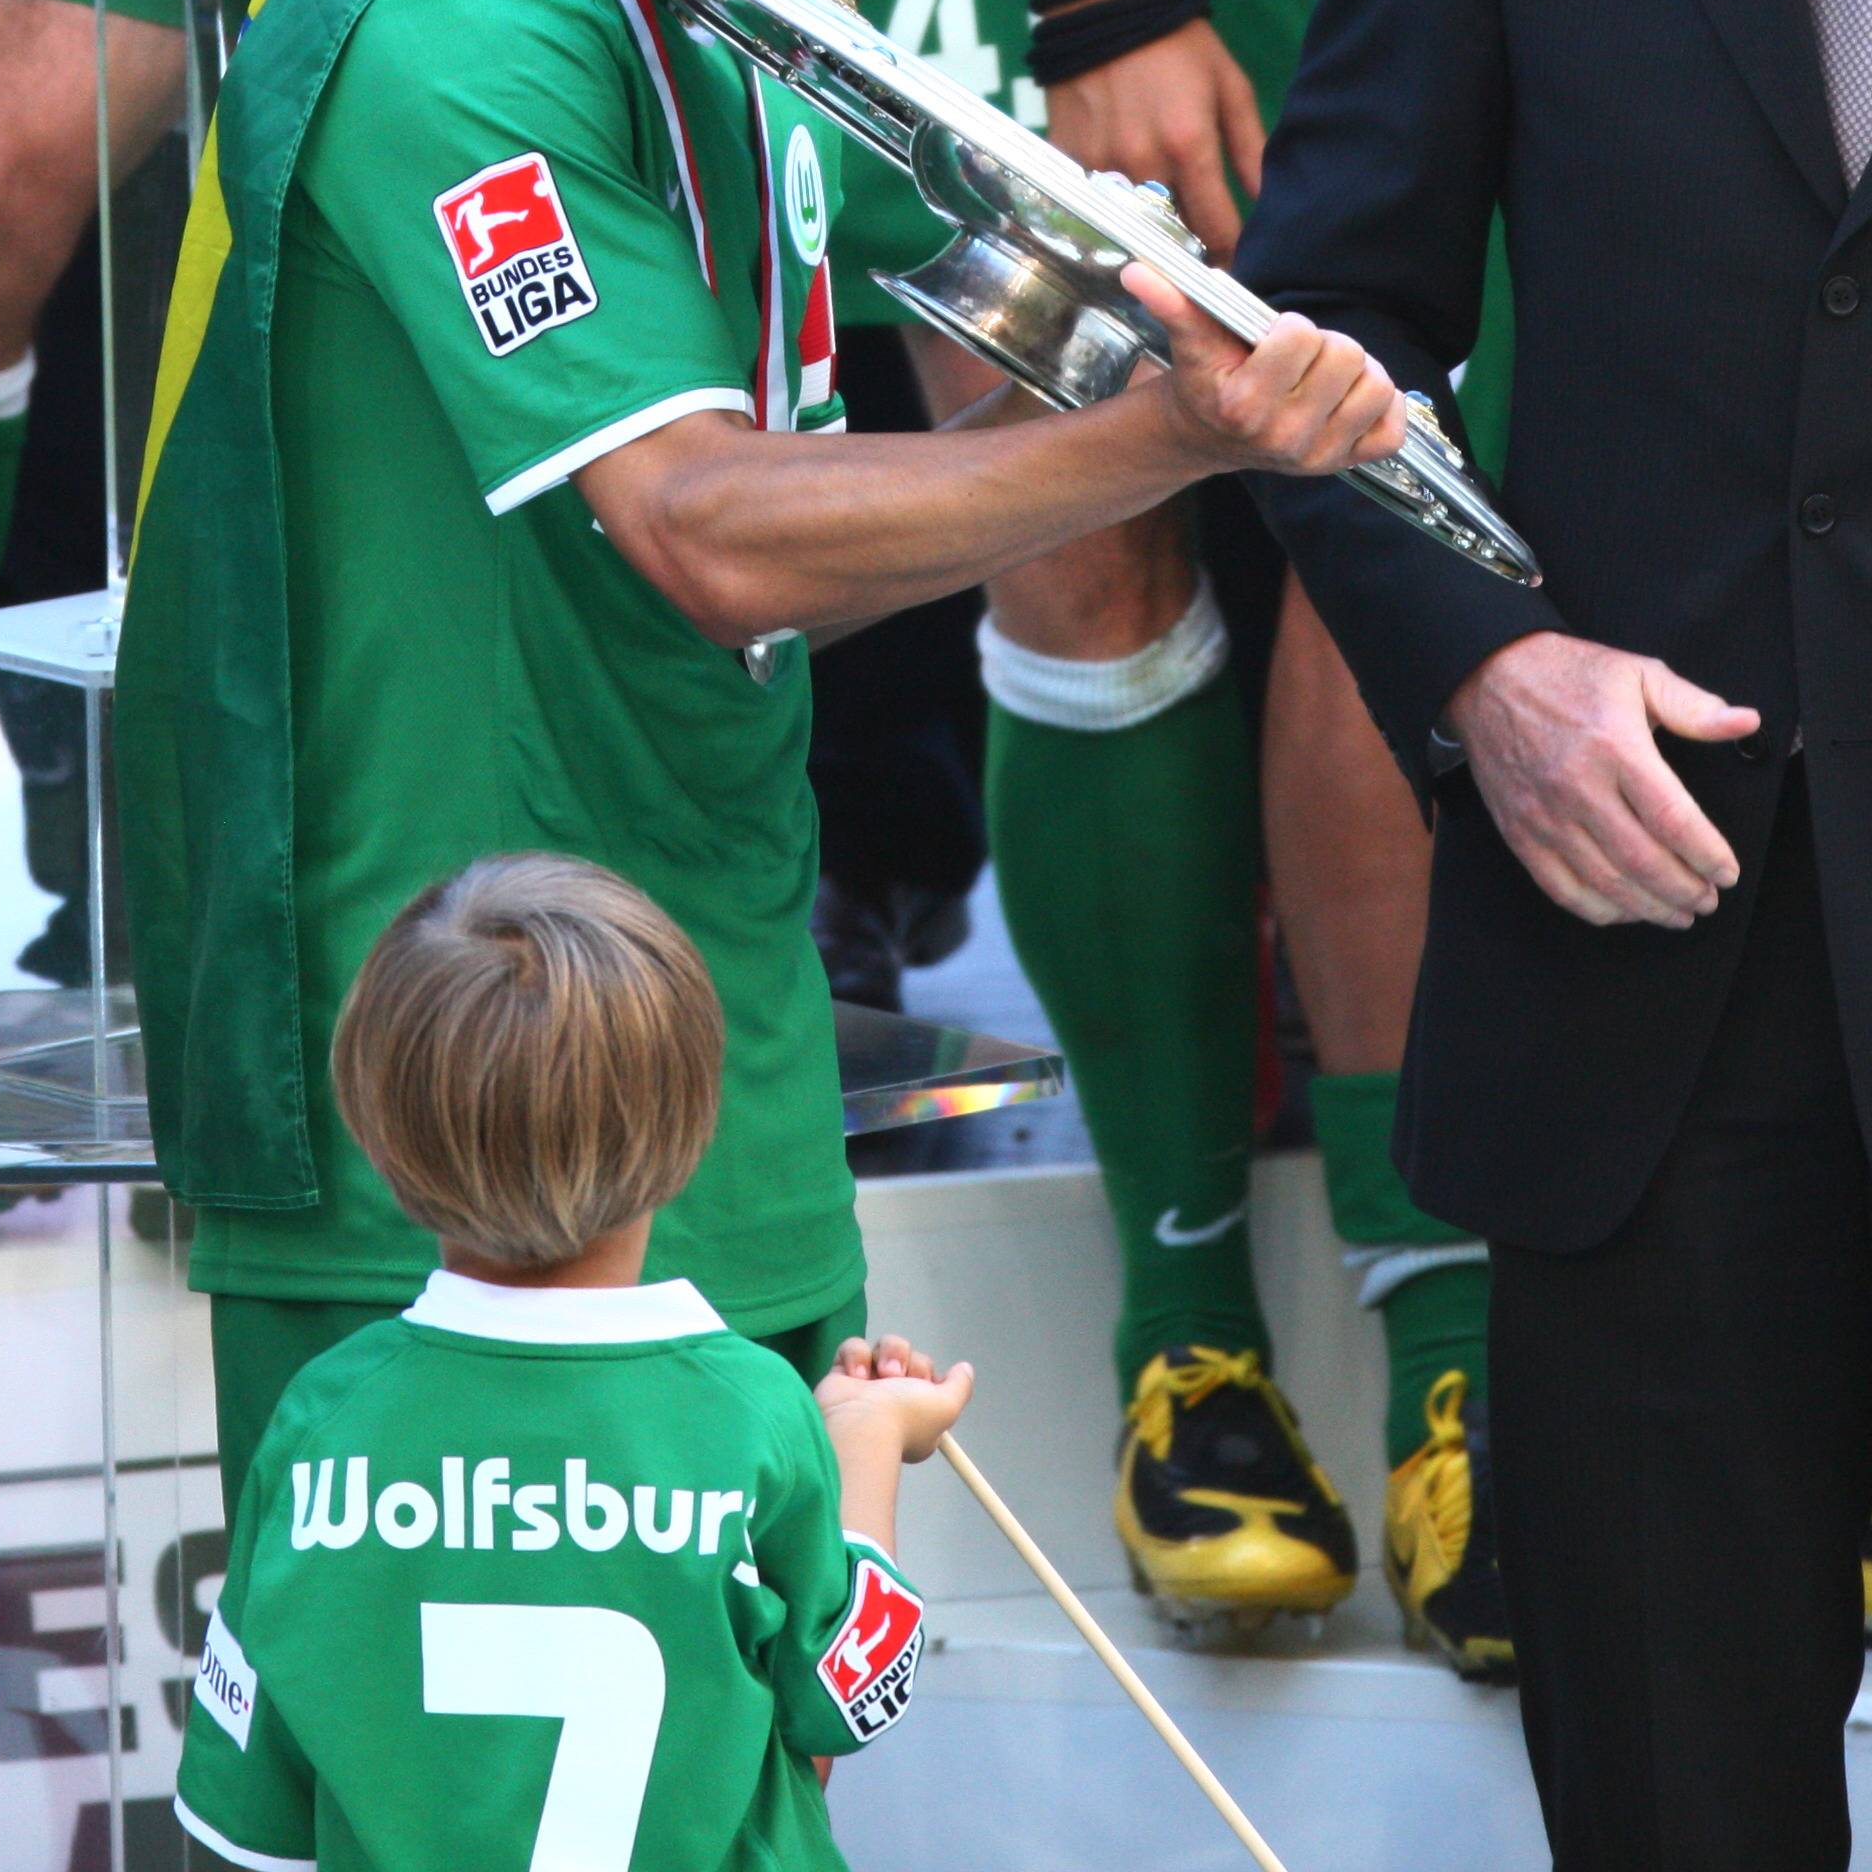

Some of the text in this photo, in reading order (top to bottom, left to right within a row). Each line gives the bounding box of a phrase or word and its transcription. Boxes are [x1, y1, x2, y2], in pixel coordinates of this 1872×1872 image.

[470, 246, 574, 308] BUNDES
[480, 271, 592, 349] LIGA
[849, 1632, 919, 1717] BUND
[420, 1601, 666, 1872] 7
